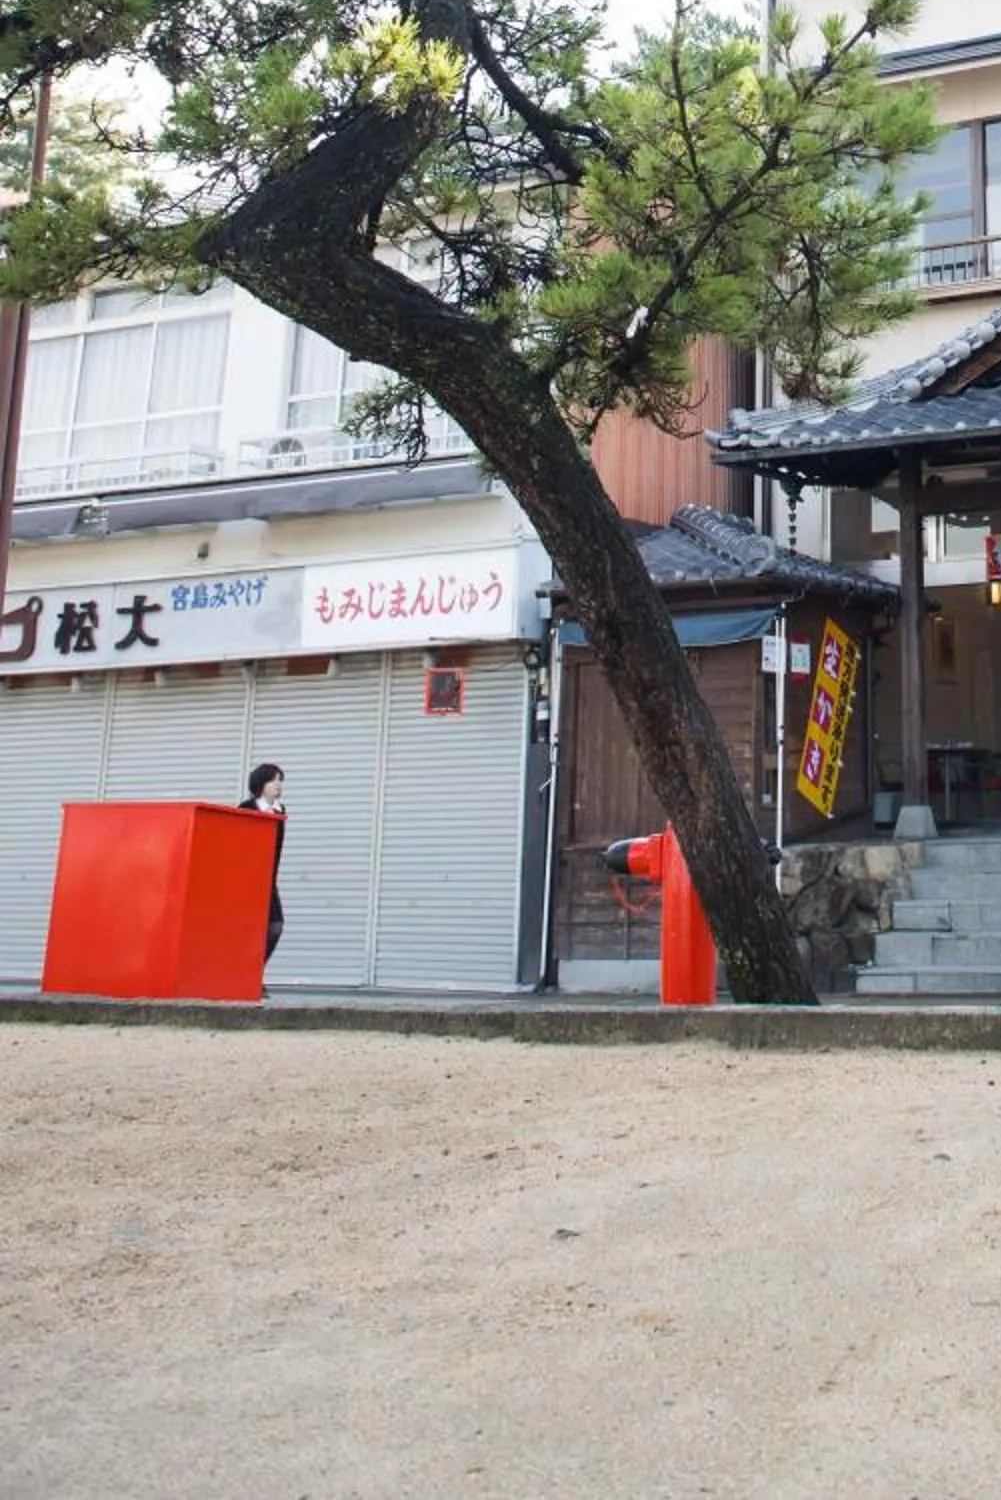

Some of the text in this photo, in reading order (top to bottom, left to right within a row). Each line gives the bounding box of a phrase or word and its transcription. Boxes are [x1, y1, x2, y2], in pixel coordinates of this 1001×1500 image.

[171, 575, 268, 611] 宮島みやげ
[314, 570, 504, 624] もみじまんじゅう
[54, 595, 163, 654] 松大
